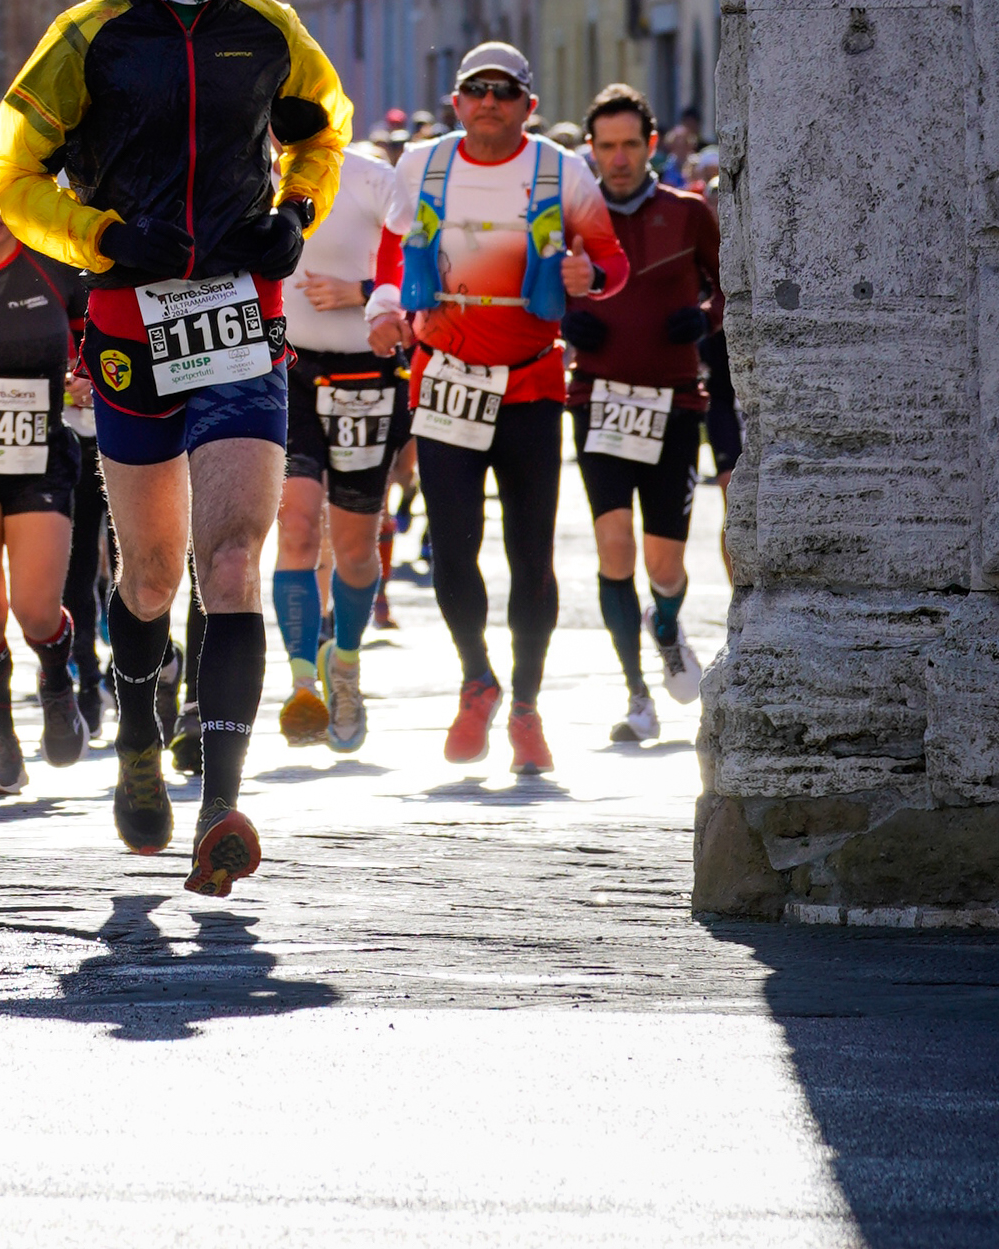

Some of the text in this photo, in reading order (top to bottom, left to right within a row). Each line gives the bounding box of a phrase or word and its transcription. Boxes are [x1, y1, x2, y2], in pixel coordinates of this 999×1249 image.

[167, 289, 196, 303] Terre
[200, 281, 234, 295] Siena
[169, 290, 238, 311] ULTRAMARATHON
[171, 308, 189, 318] 2024
[169, 306, 242, 356] 116
[181, 356, 211, 370] UISP
[171, 367, 214, 384] sportpertutti
[434, 380, 482, 421] 101
[602, 402, 653, 438] 204
[337, 416, 367, 447] 81
